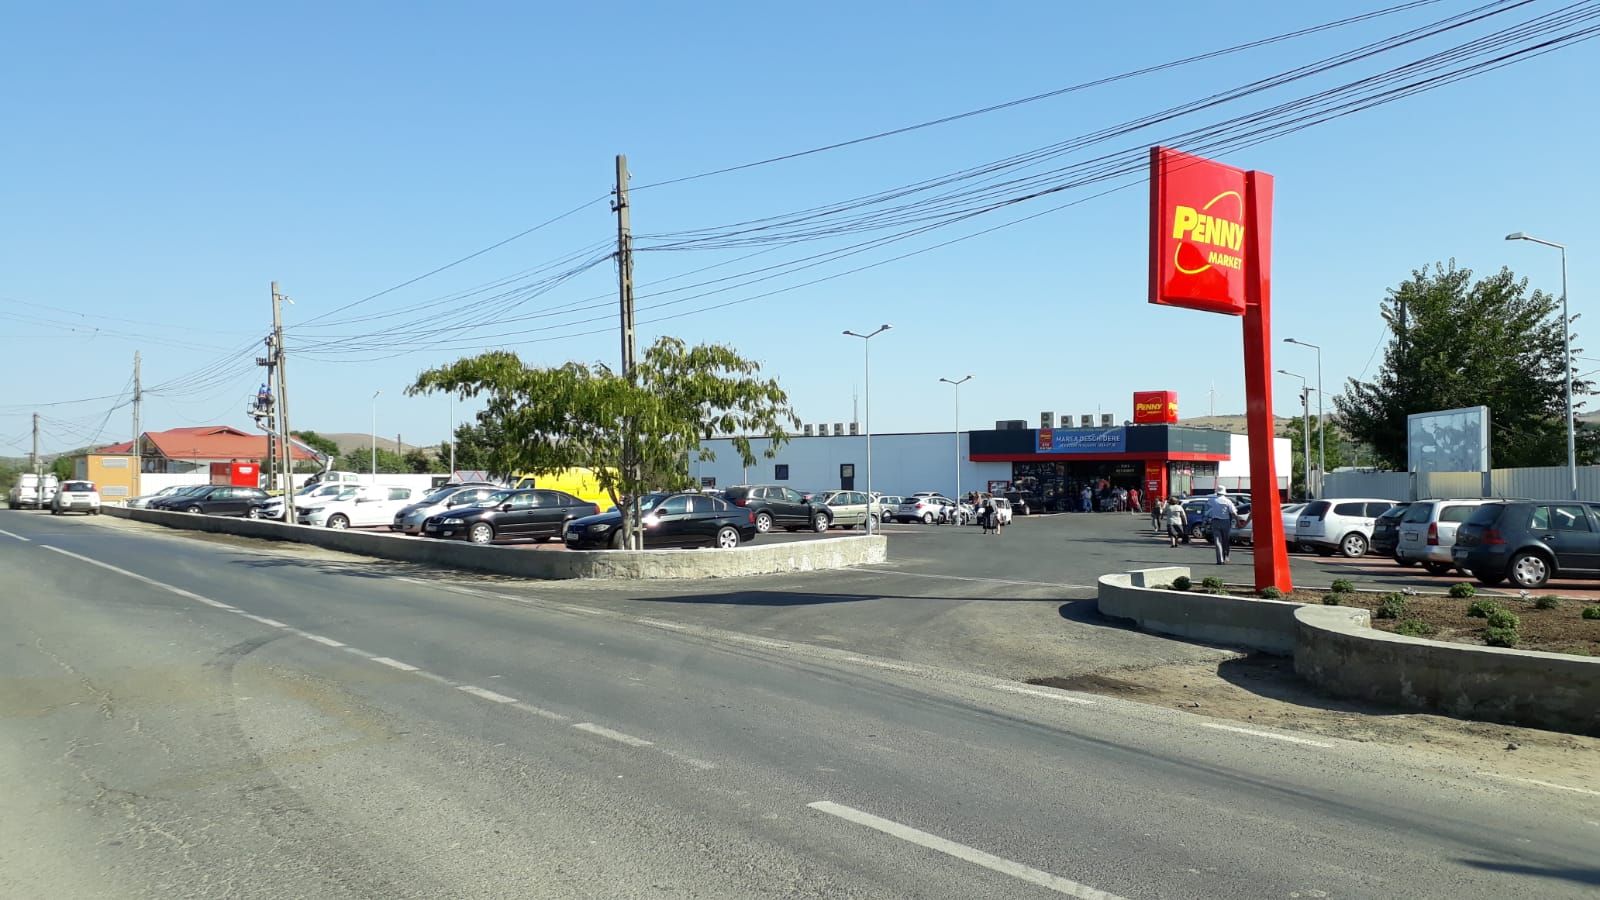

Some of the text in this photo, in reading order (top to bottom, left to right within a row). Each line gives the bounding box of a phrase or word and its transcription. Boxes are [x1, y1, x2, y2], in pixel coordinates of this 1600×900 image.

[1172, 205, 1245, 252] PENNY
[1208, 251, 1242, 270] MARKET
[1136, 403, 1163, 411] PENNY
